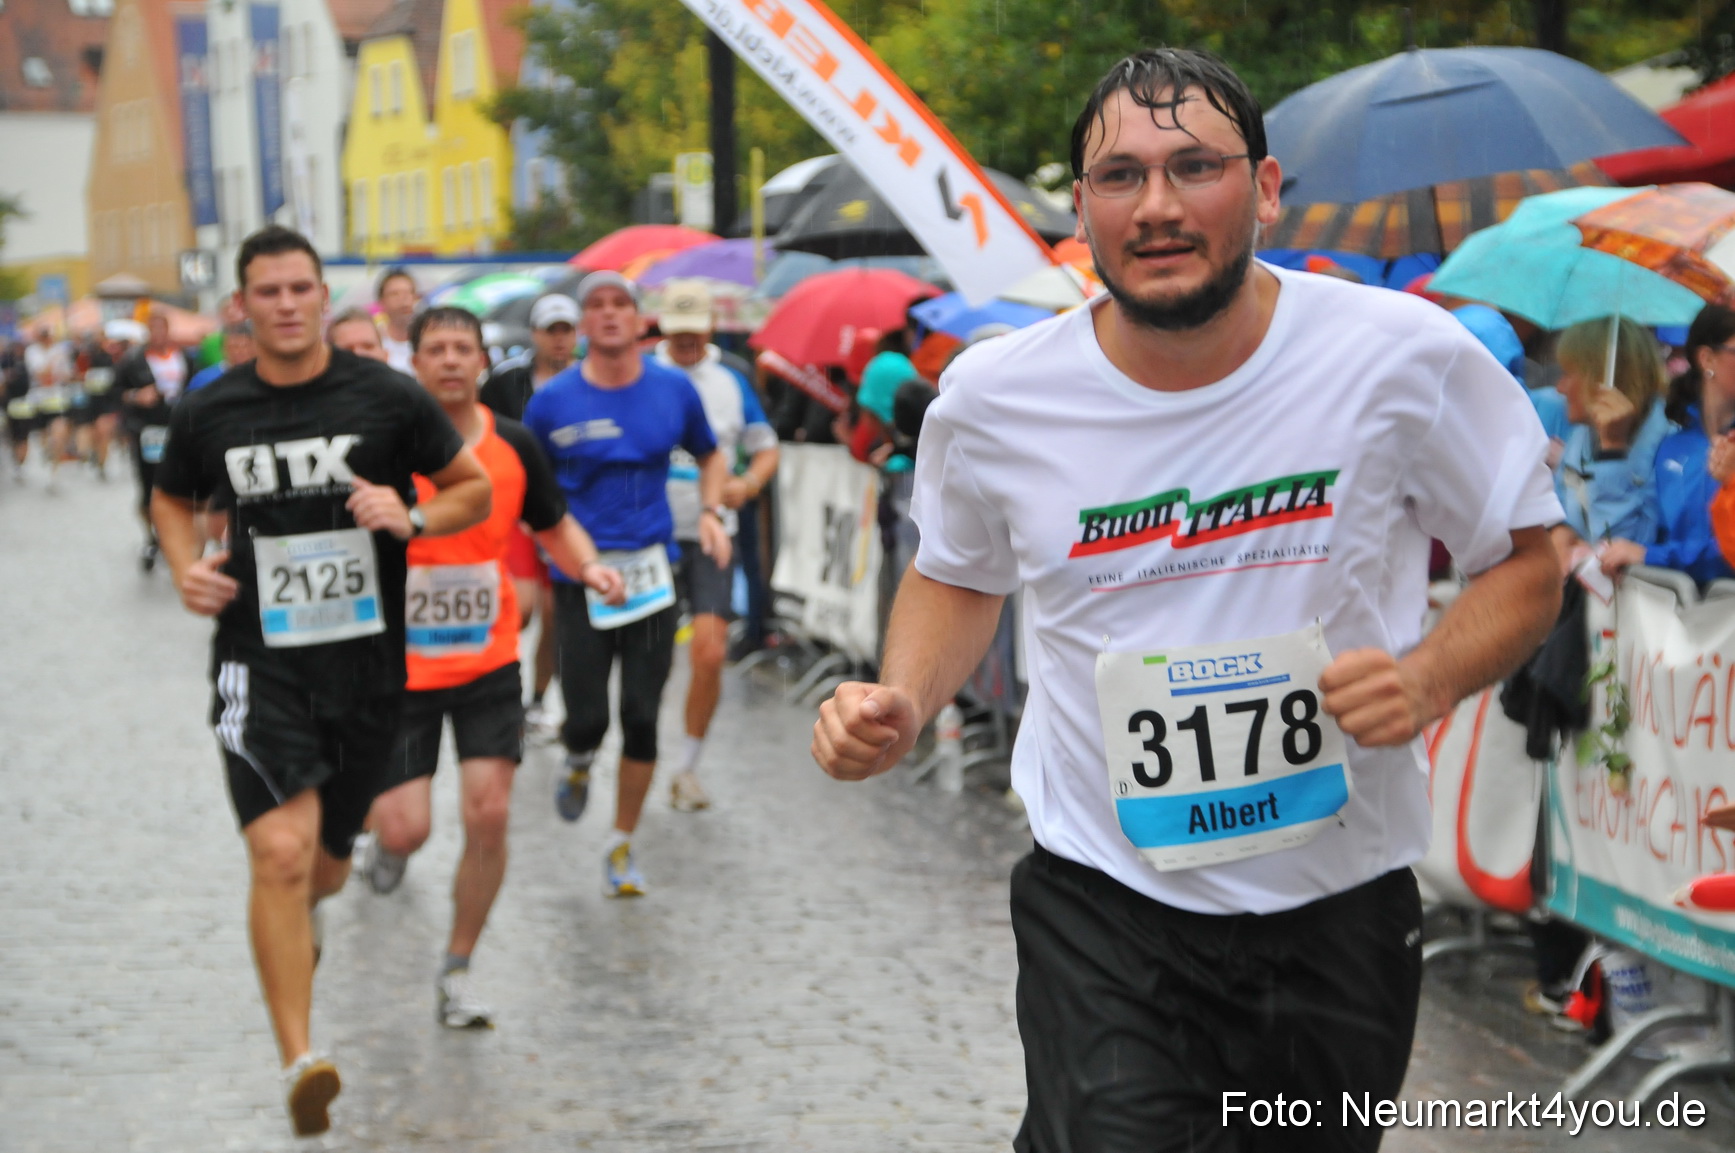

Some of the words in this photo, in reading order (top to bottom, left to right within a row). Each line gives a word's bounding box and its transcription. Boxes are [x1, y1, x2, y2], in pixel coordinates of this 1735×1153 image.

[274, 434, 362, 488] TX
[1185, 477, 1327, 539] ITALIA
[271, 559, 365, 604] 2125
[1088, 571, 1124, 585] FEINE
[1138, 555, 1226, 580] ITALIENISCHE
[1237, 543, 1331, 563] SPEZIALITÄTEN
[409, 587, 491, 624] 2569
[1168, 652, 1264, 683] BOCK
[1127, 689, 1323, 789] 3178
[1188, 791, 1280, 835] Albert
